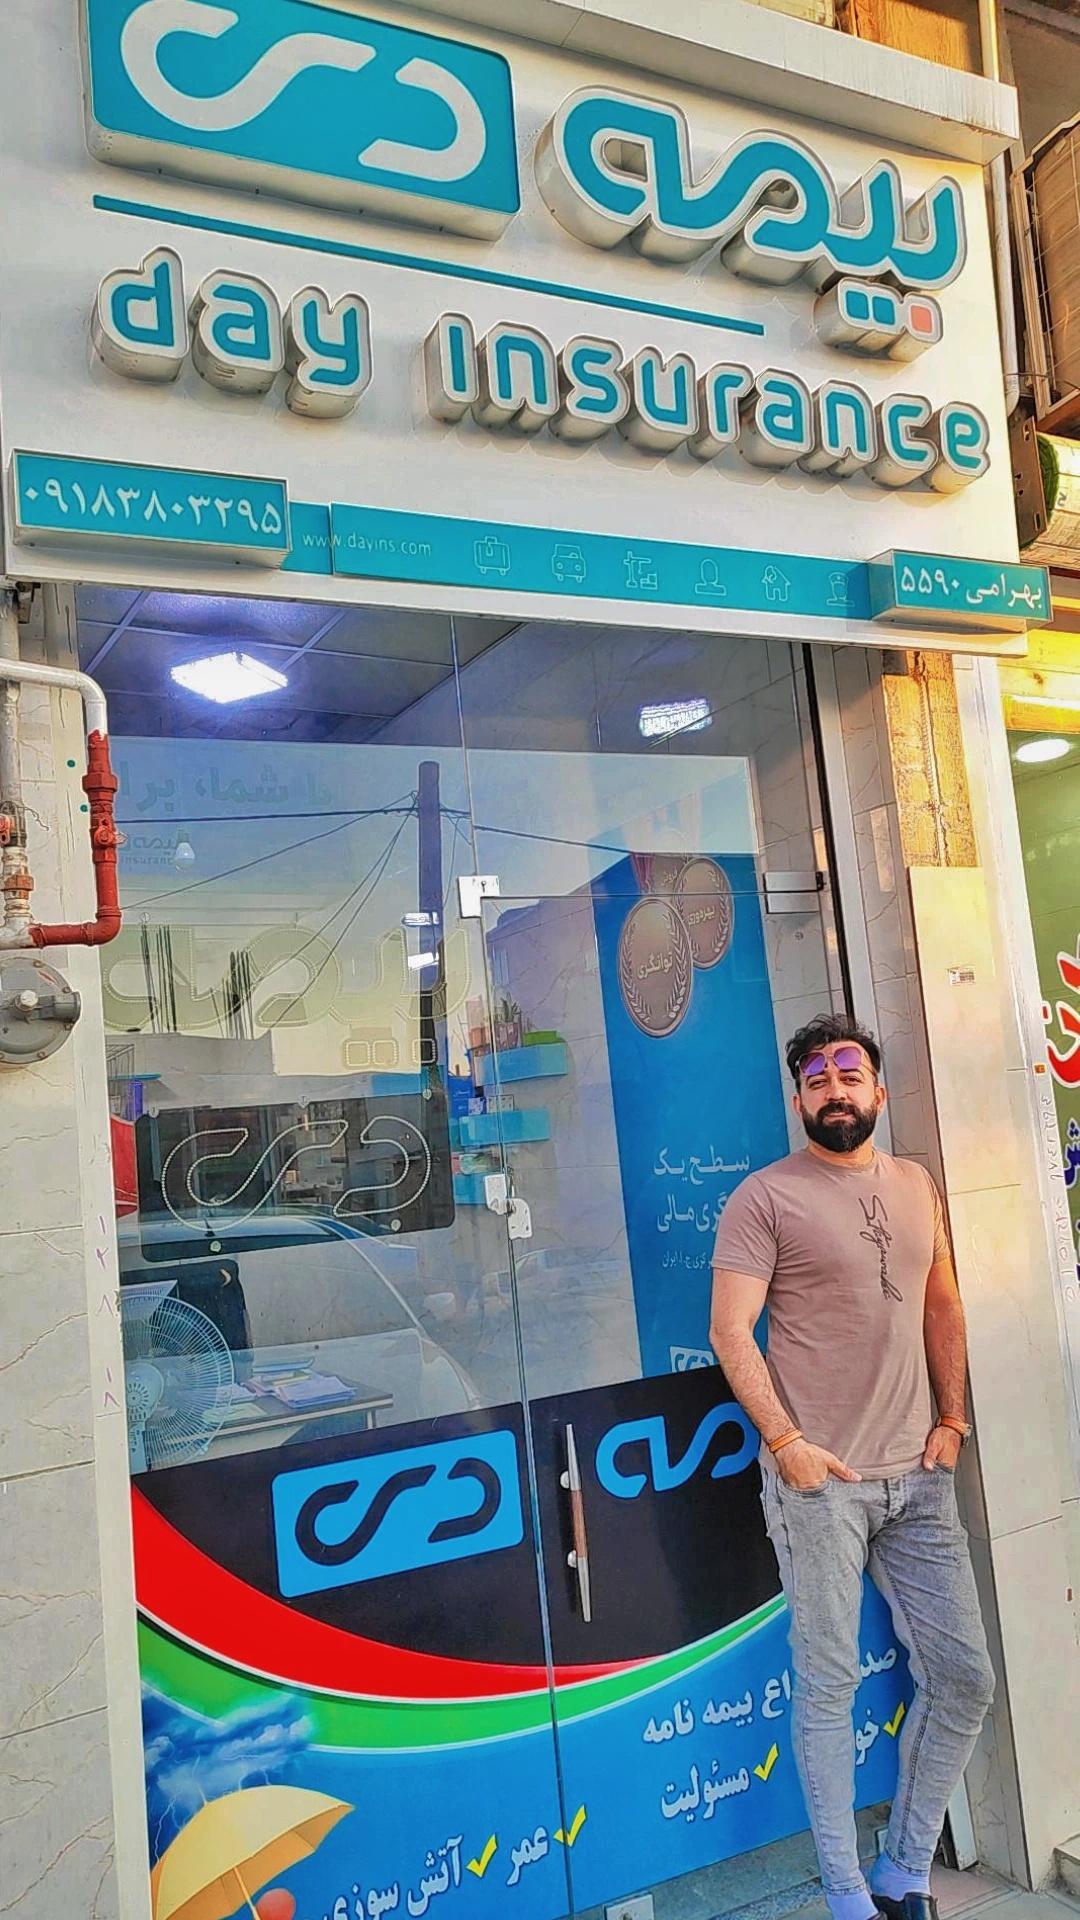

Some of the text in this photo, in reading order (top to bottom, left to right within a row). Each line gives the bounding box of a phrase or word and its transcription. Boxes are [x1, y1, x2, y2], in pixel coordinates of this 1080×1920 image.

[555, 90, 964, 338] بیمه
[105, 252, 368, 396] day
[302, 532, 432, 556] www.dayins.com
[965, 573, 1043, 610] بهرامی
[637, 950, 673, 980] توانگری
[653, 1144, 750, 1186] سطح یک
[656, 1192, 695, 1233] مالی
[642, 1697, 695, 1744] نامه
[701, 1689, 754, 1727] بیمه
[660, 1758, 750, 1823] مسئولیت
[406, 1833, 464, 1917] آتش
[506, 1825, 549, 1887] عمر
